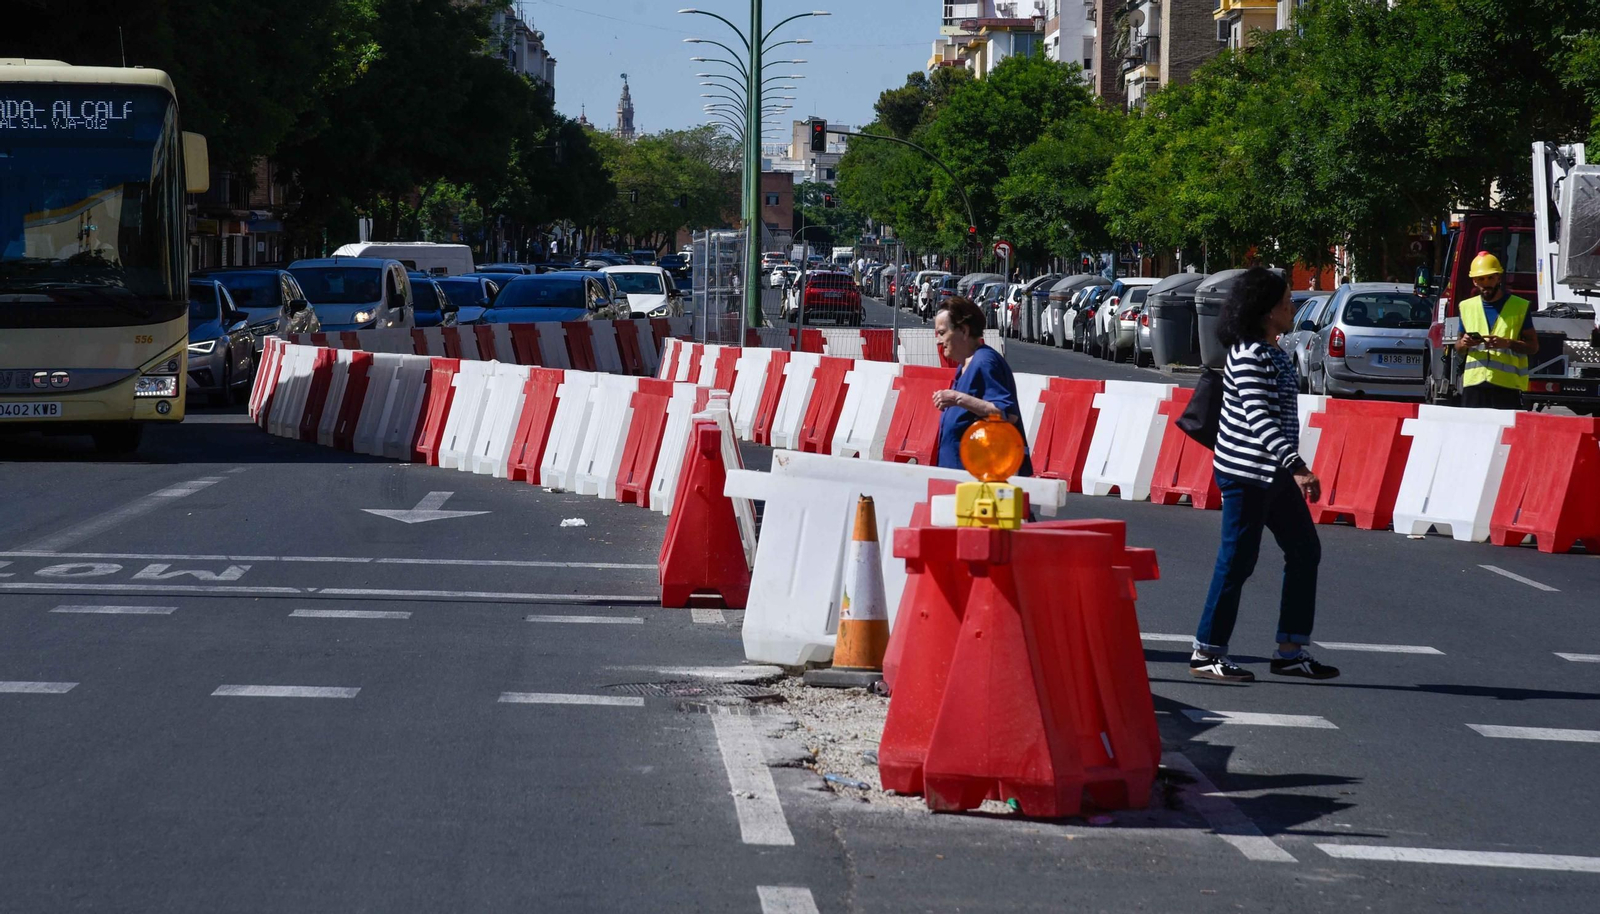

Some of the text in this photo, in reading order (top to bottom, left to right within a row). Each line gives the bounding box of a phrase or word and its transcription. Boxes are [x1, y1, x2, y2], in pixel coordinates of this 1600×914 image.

[21, 117, 47, 129] S.L.
[134, 334, 153, 345] 556
[33, 403, 58, 416] KWB
